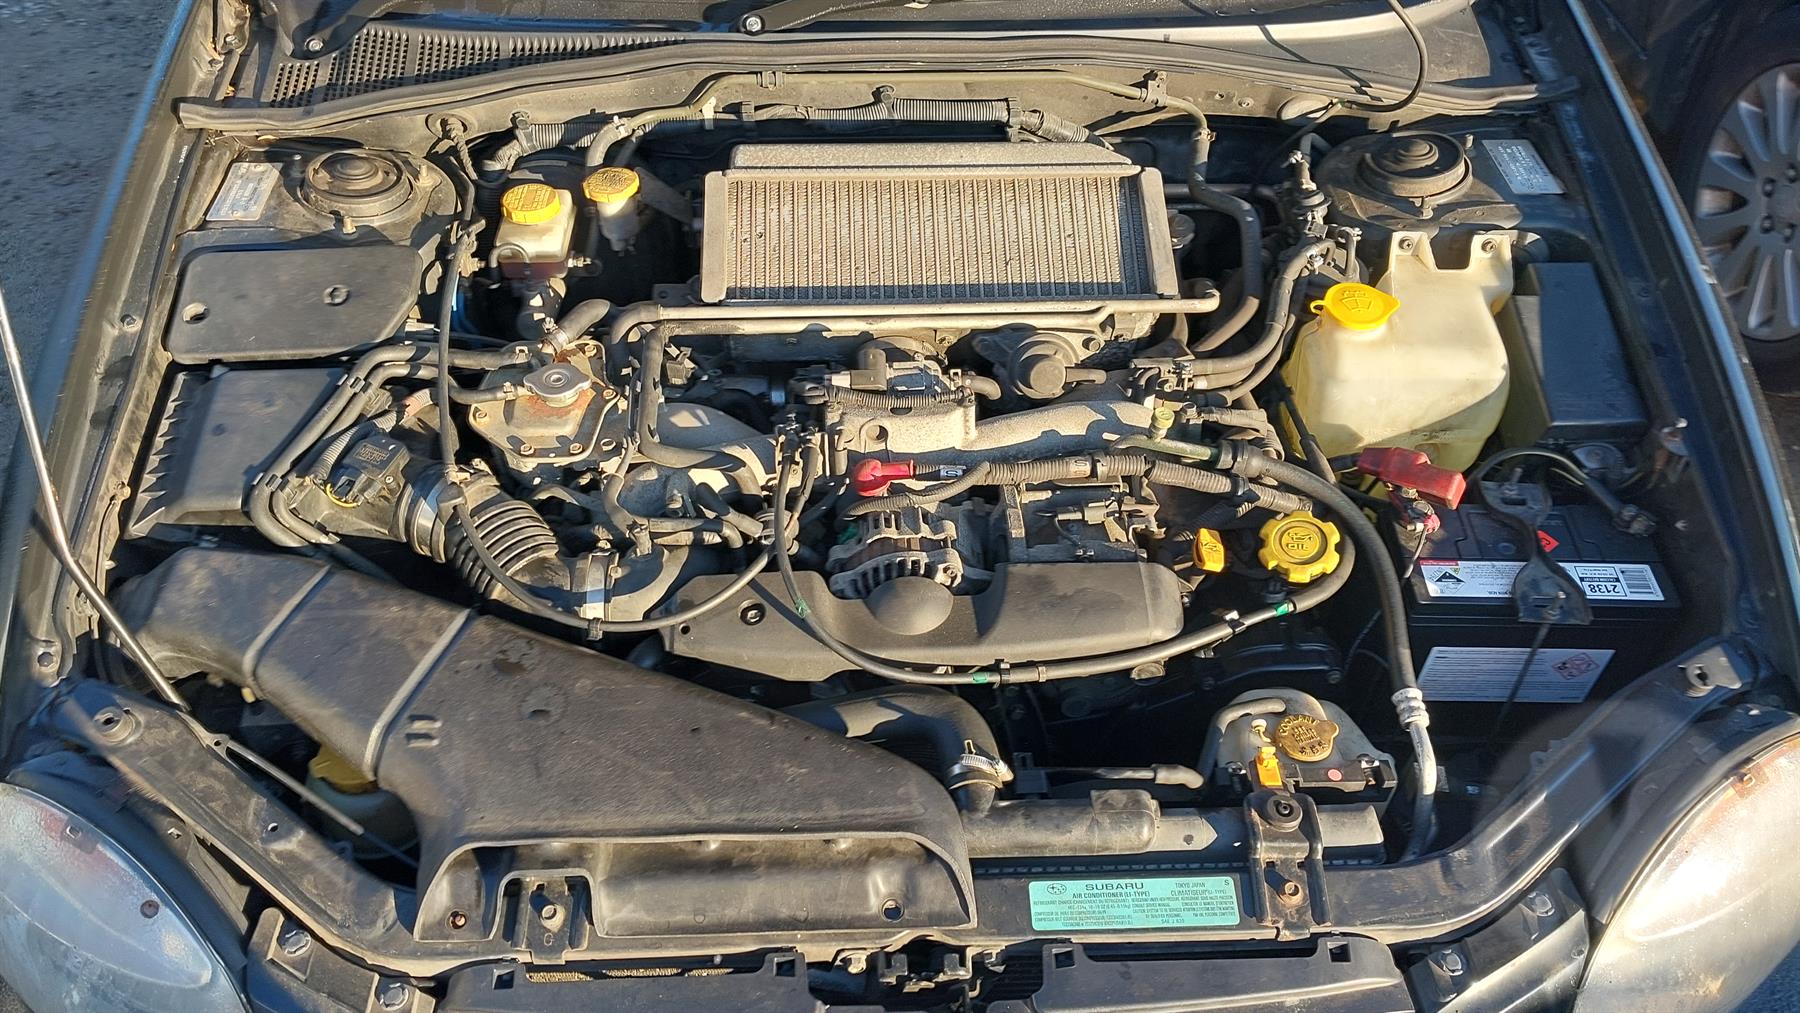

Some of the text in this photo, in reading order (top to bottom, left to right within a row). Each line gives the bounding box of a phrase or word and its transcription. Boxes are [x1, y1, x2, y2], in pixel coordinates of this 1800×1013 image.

[1286, 542, 1309, 551] OIL
[1588, 583, 1620, 594] 2138
[1278, 714, 1320, 736] COOLANT
[1085, 882, 1145, 891] SUBARU
[1084, 891, 1125, 899] CONDITIONER
